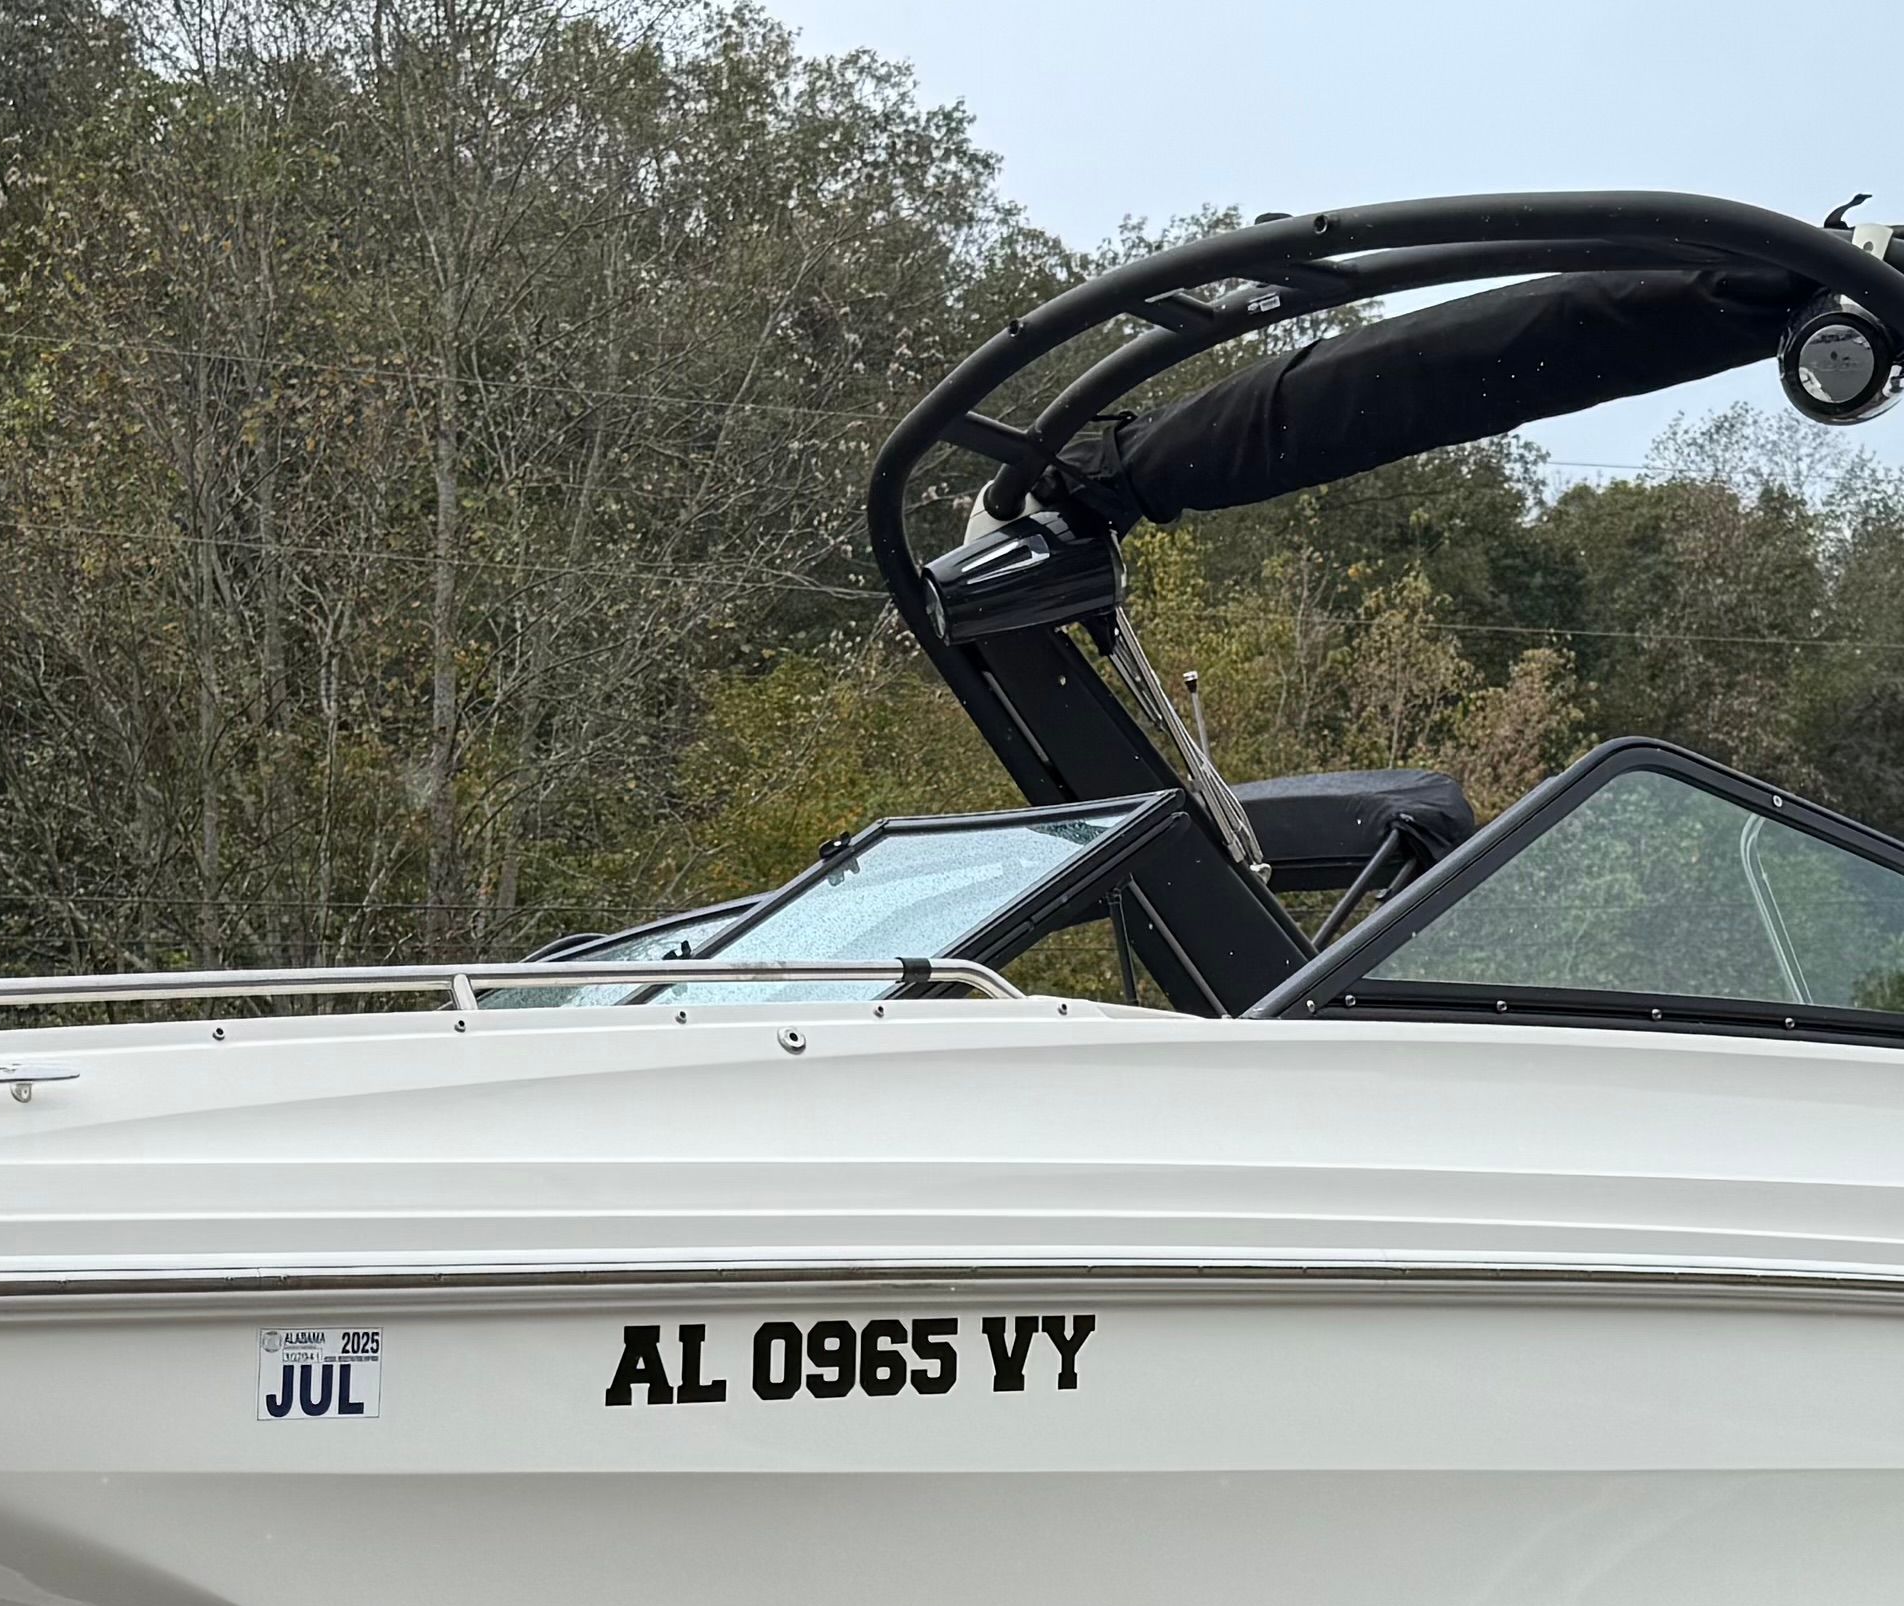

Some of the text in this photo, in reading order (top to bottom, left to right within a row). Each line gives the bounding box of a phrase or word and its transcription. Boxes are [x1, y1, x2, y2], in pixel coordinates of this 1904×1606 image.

[341, 1331, 380, 1354] 2025
[605, 1315, 1095, 1406] AL 0965 VY
[265, 1364, 364, 1418] JUL
